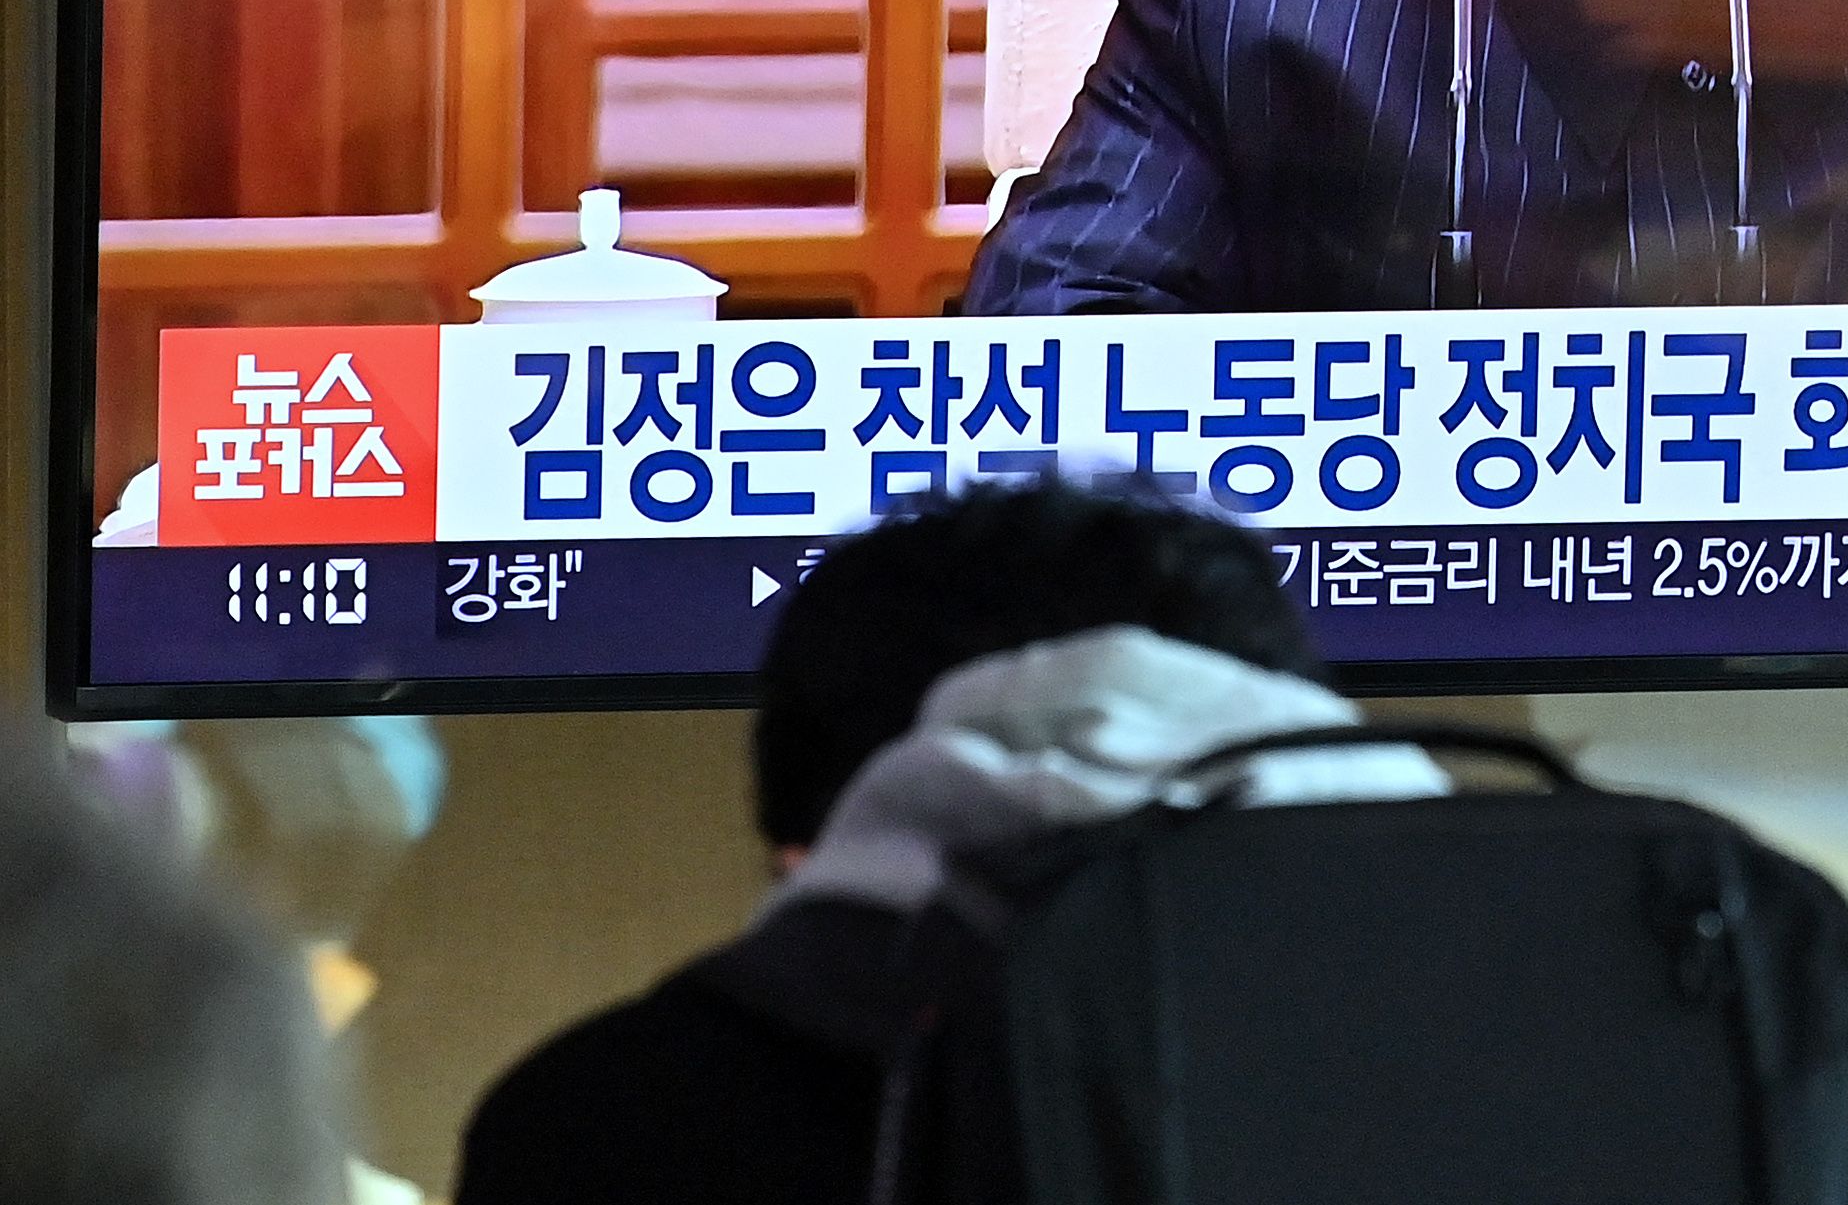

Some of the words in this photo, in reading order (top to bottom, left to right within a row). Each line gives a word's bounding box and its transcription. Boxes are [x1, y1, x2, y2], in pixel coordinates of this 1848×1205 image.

[232, 353, 373, 425] 뉴스
[509, 341, 826, 522] 김정은
[852, 339, 1061, 515] 참석
[1091, 333, 1415, 513] 노동당
[1439, 330, 1756, 511] 정치국
[194, 426, 405, 500] 포커스
[228, 558, 367, 625] 11:10
[1271, 537, 1498, 608] 기준금리
[1523, 534, 1633, 602] 내년
